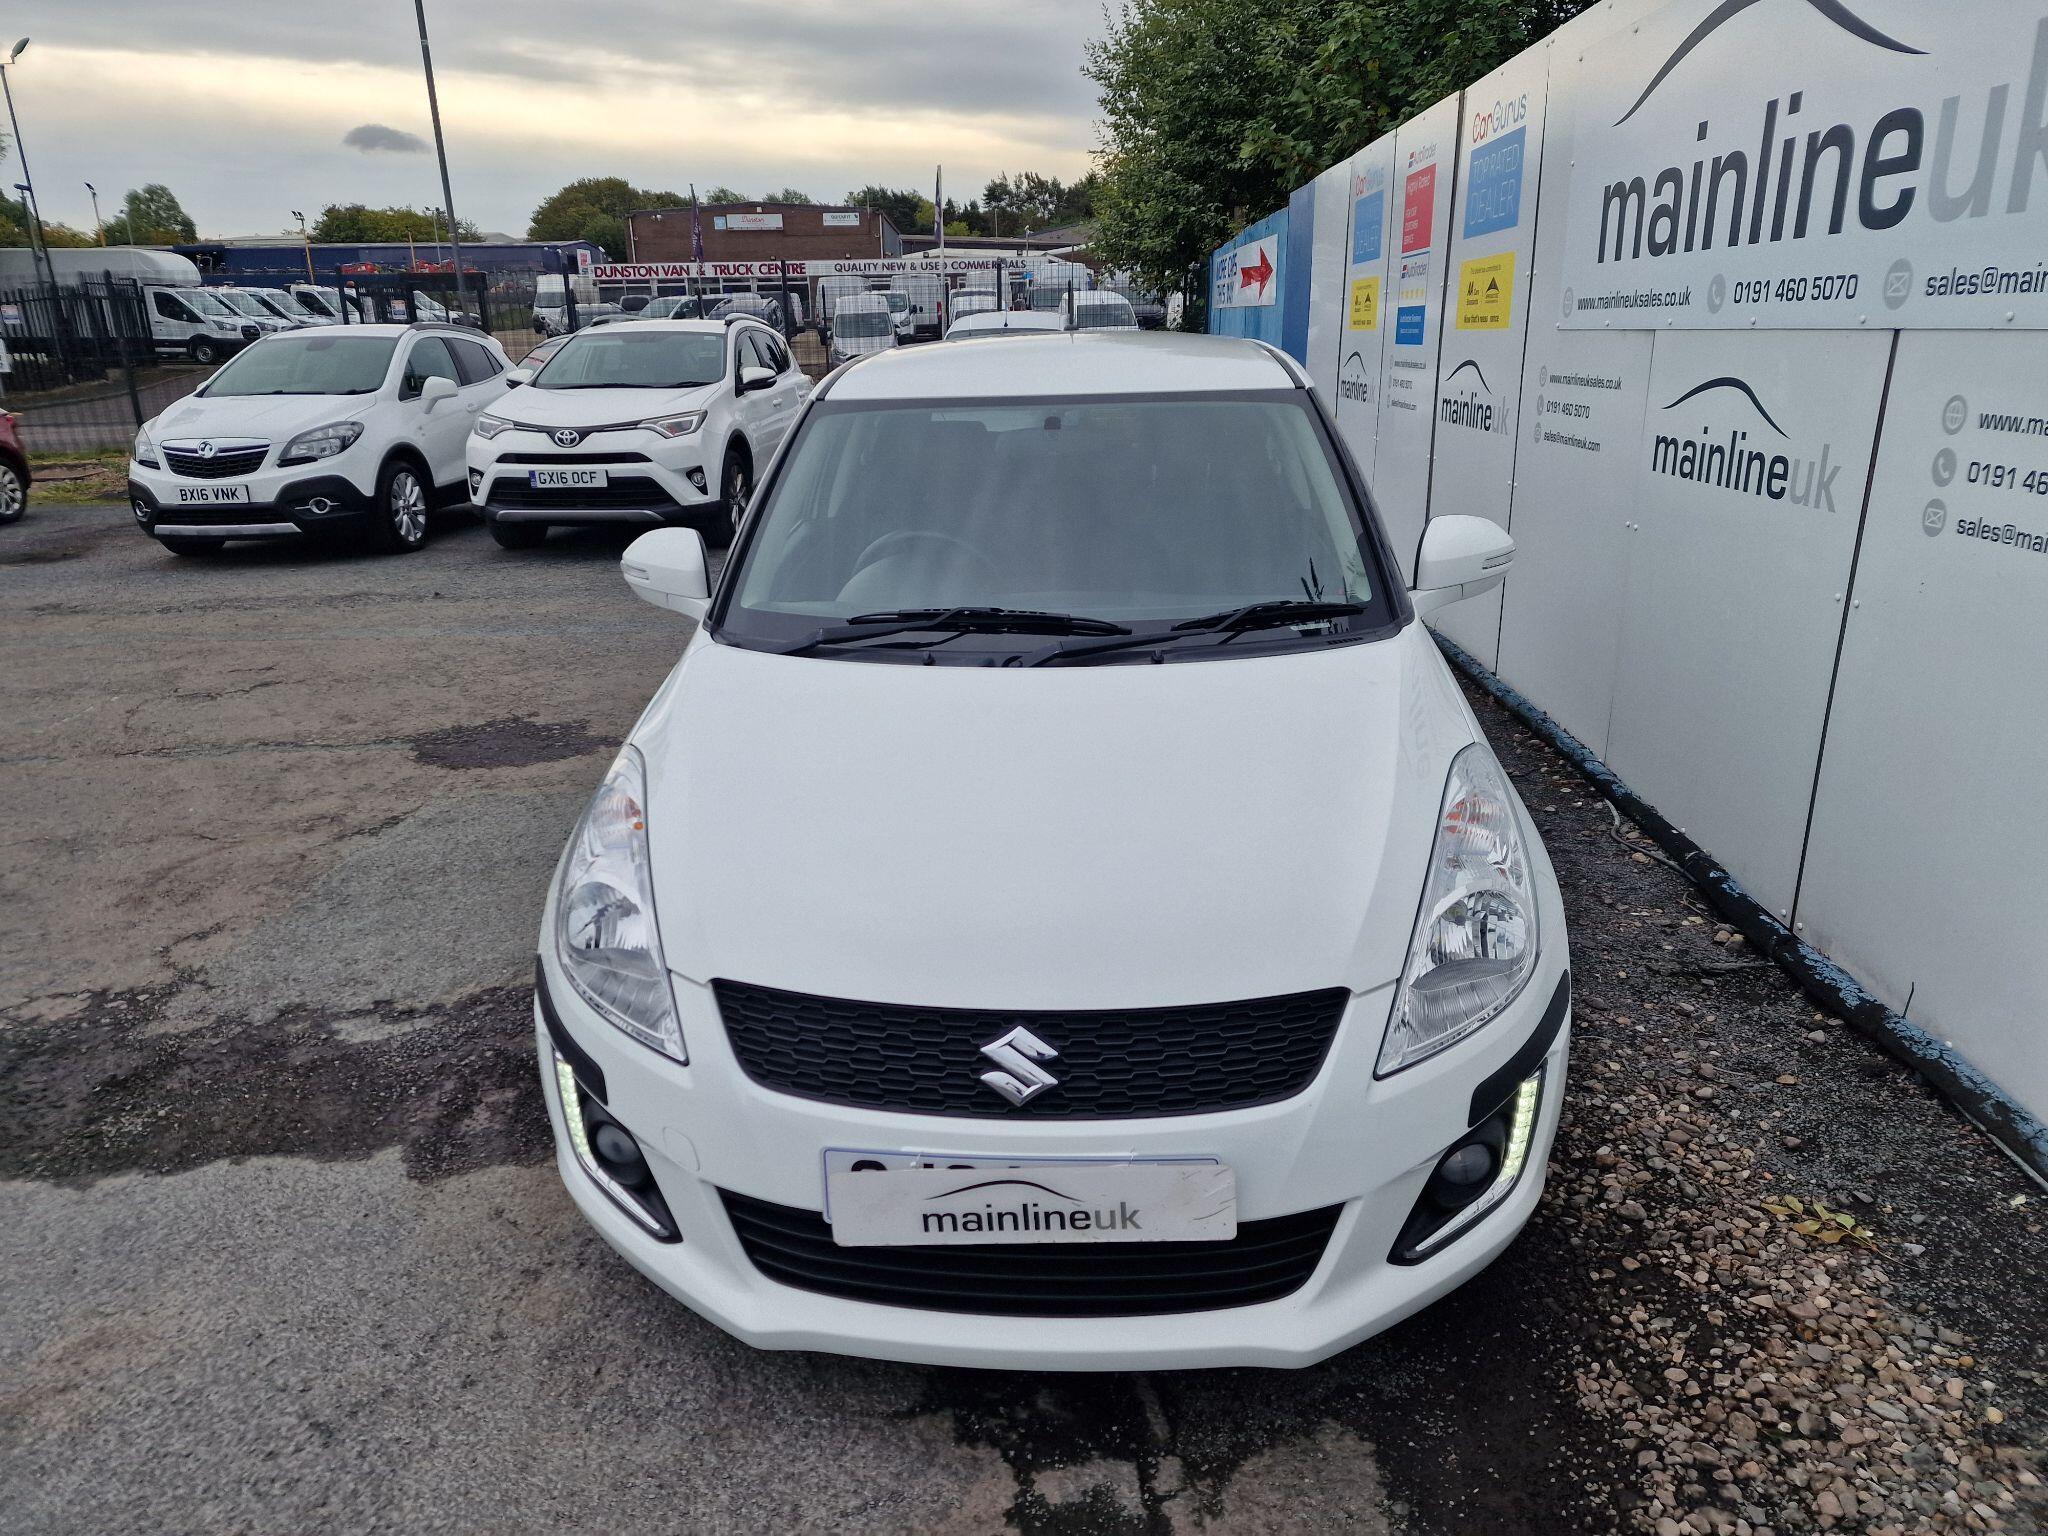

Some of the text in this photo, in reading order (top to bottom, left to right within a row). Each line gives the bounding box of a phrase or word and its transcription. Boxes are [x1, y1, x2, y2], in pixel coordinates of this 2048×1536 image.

[1472, 94, 1527, 143] CarGurus
[1472, 144, 1521, 185] TOP RATED
[1470, 179, 1518, 225] DEALER
[594, 265, 659, 278] DUNSTON
[661, 264, 690, 277] VAN
[712, 263, 753, 276] TRUCK
[758, 262, 806, 275] CENTRE
[834, 262, 879, 273] QUALITY
[882, 261, 906, 272] NEW
[909, 261, 917, 271] &
[1577, 285, 1692, 311] www.mainlineuksales.co.uk
[1734, 274, 1859, 304] 0191 460 5070
[1549, 373, 1623, 391] www.mainlineuksales.co.uk
[1440, 391, 1509, 436] mainlineuk
[1546, 400, 1591, 419] 0191 460 5070
[538, 470, 597, 485] GX16 OCF
[1651, 427, 1843, 514] mainlineuk
[1967, 461, 2018, 490] 0191
[179, 487, 240, 502] BX16 VNK
[922, 1201, 1142, 1233] mainlineuk
